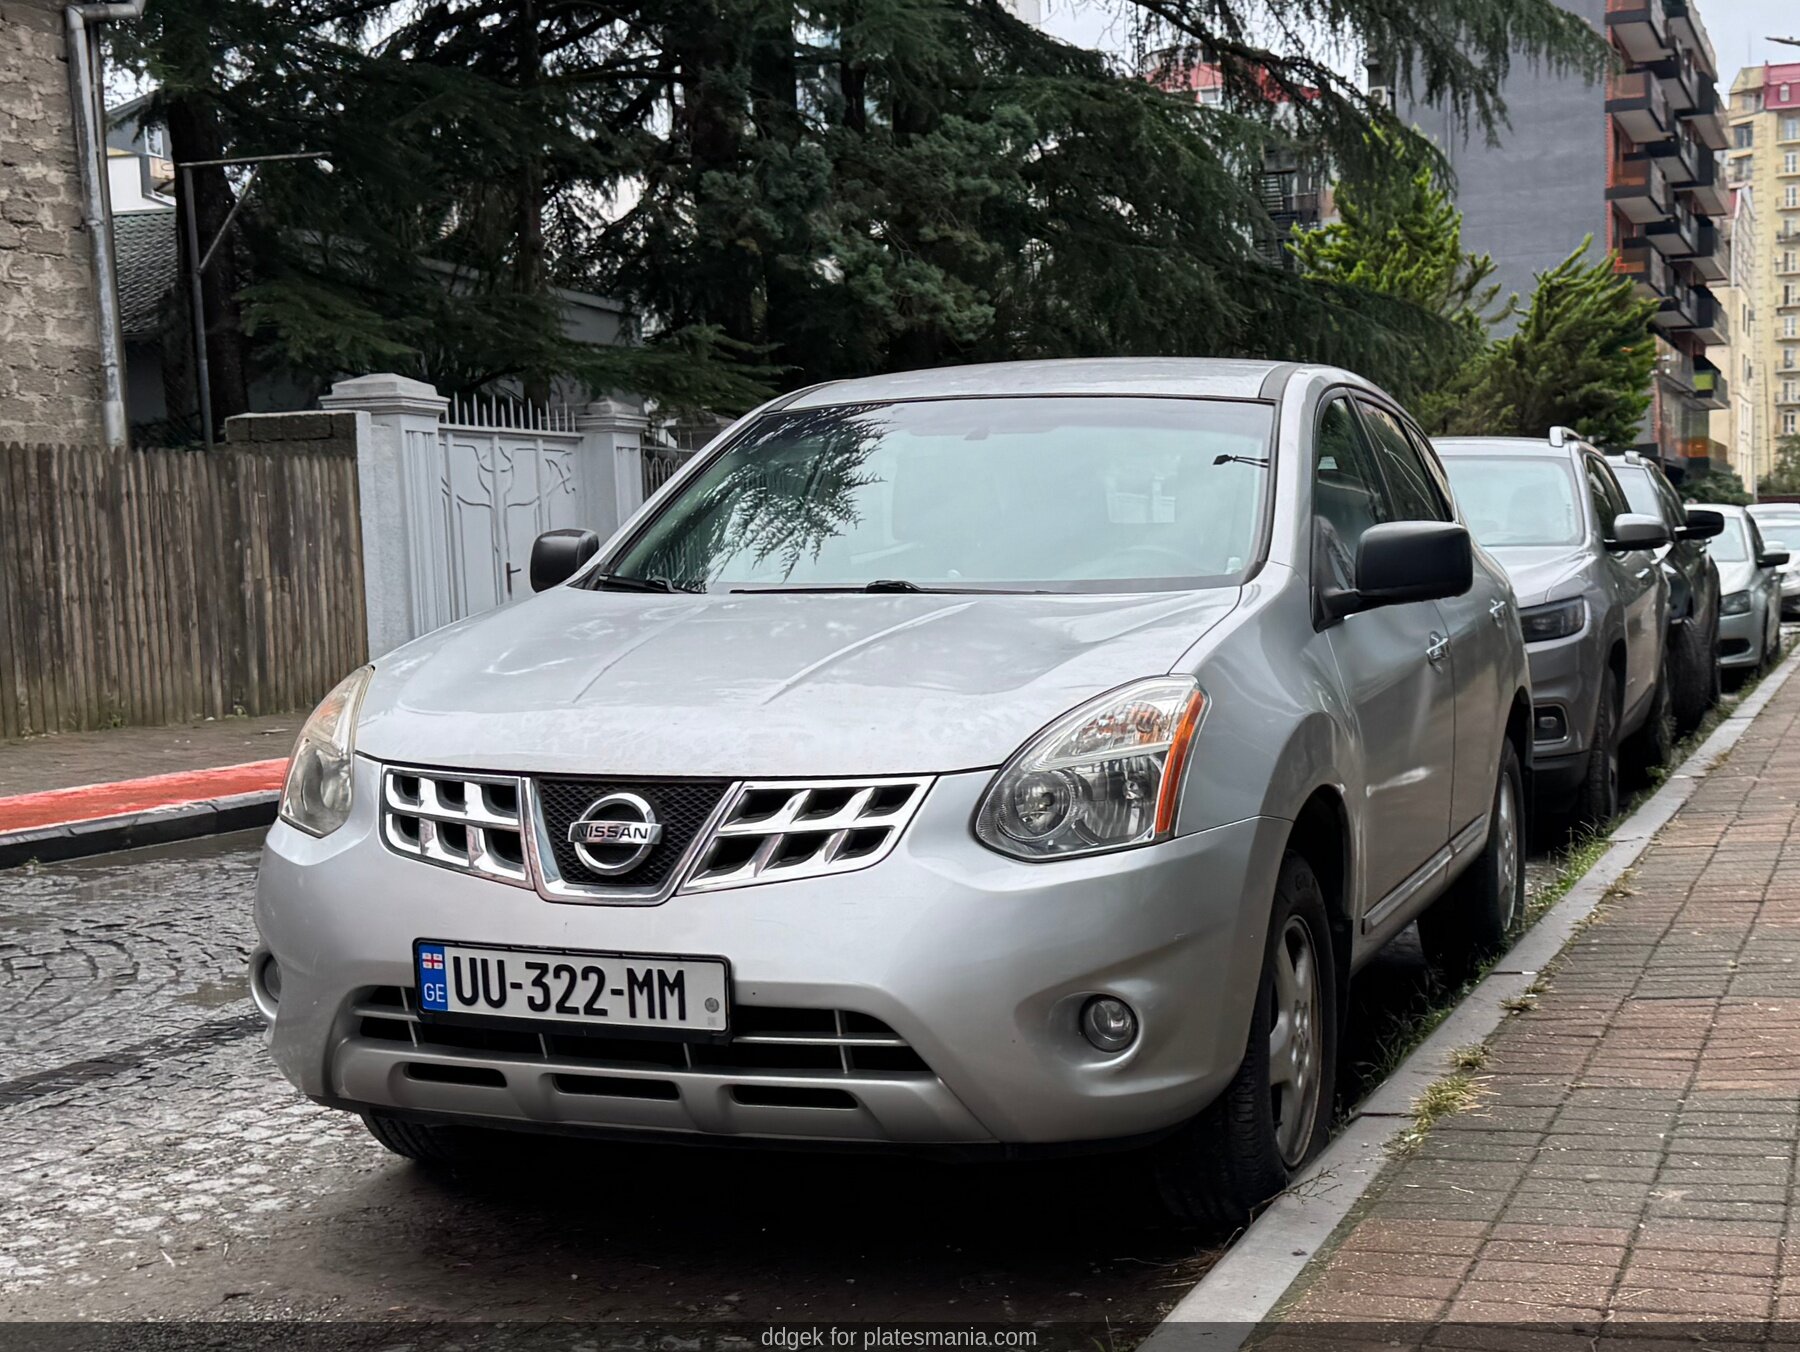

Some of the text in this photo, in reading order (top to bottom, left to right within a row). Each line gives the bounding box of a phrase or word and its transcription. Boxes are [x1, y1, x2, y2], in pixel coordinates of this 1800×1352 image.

[577, 825, 648, 839] NISSAN
[423, 982, 445, 1003] GE
[453, 956, 686, 1020] UU-322-MM
